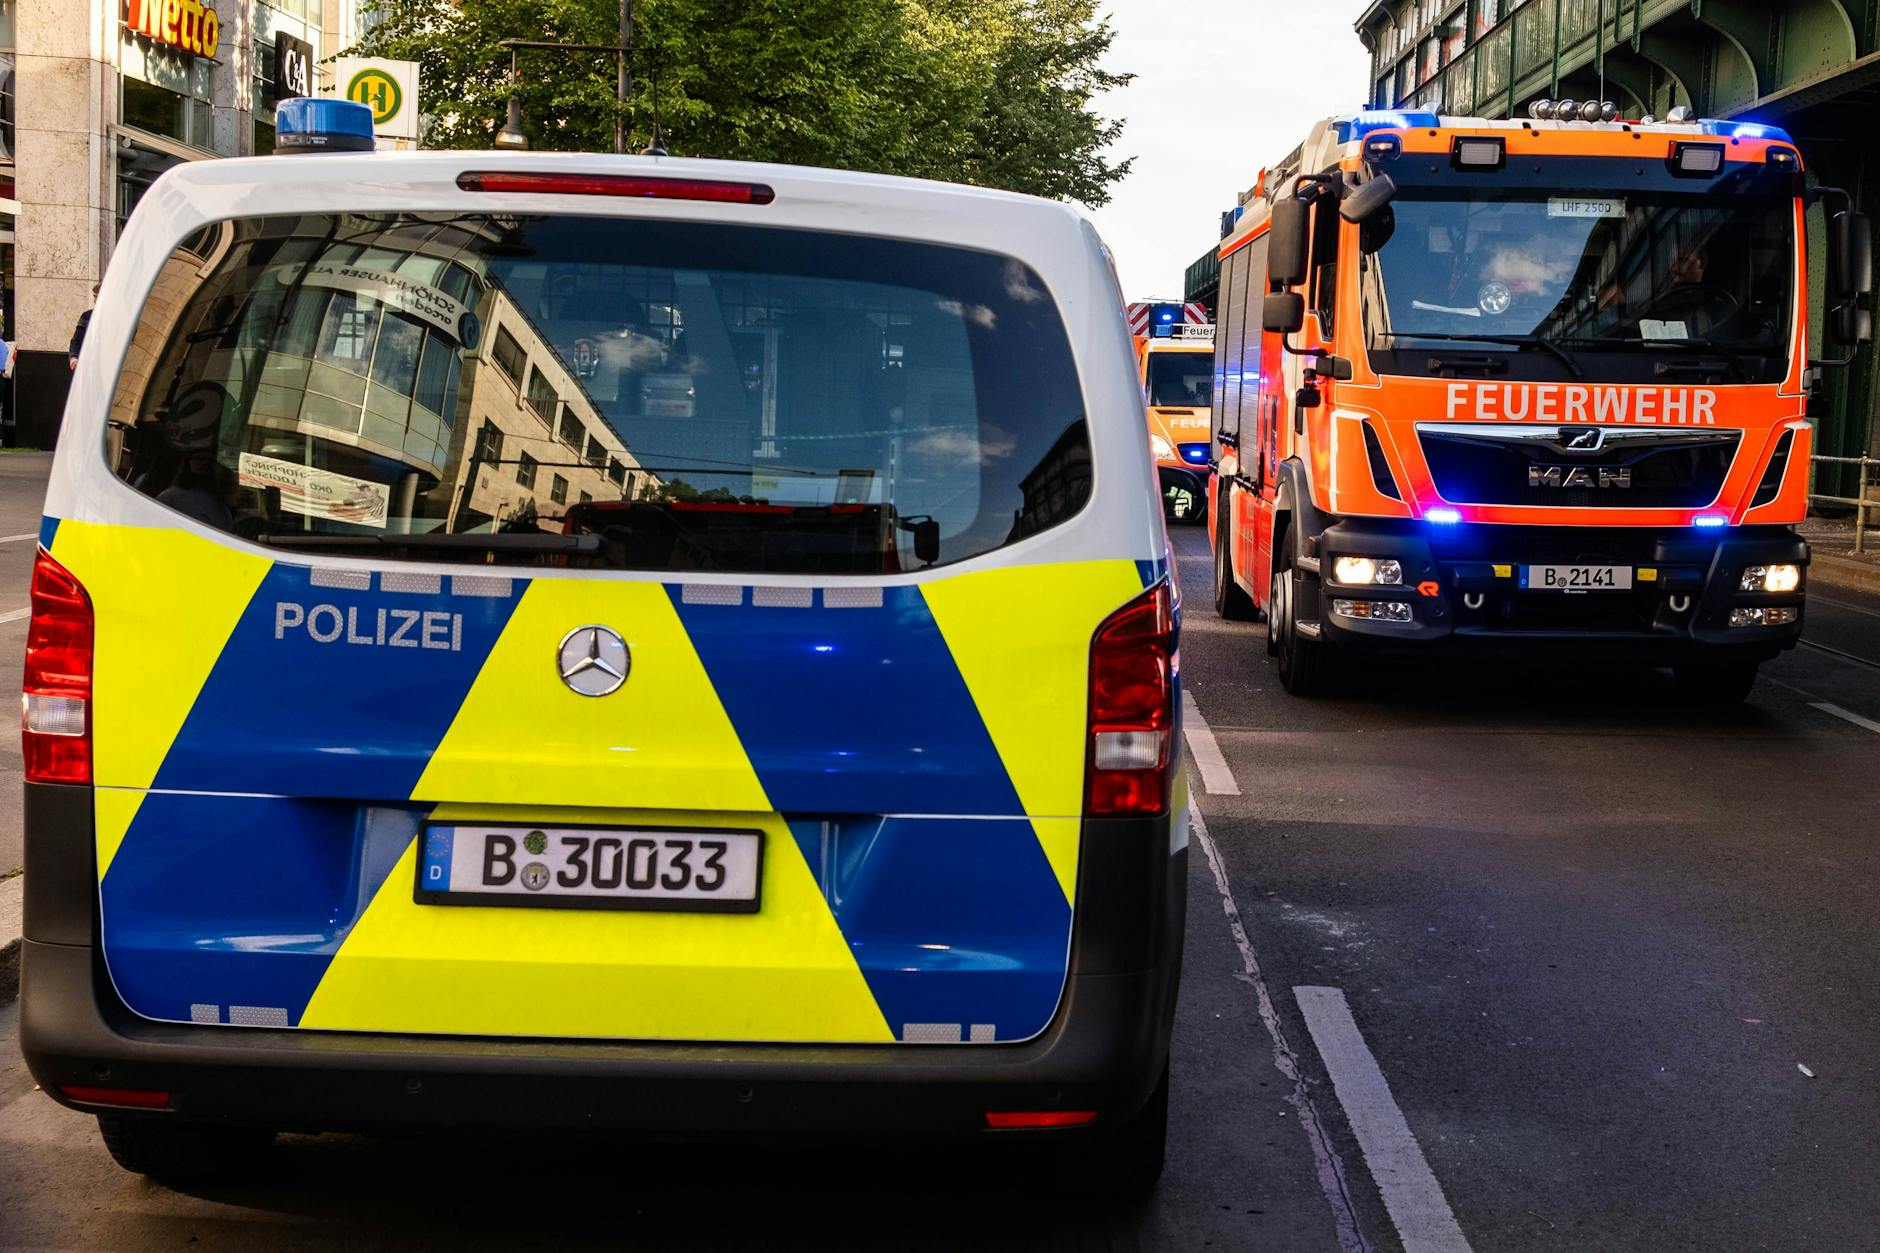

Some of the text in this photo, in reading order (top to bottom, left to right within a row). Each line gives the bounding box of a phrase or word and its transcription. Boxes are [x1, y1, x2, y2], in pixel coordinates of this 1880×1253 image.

[138, 0, 219, 58] Netto
[284, 48, 309, 97] C&A
[1562, 202, 1612, 213] LHF 2500
[1446, 383, 1717, 425] FEUERWEHR
[1528, 466, 1632, 488] MAN
[1544, 568, 1557, 586] B
[1569, 568, 1616, 587] 2141
[275, 601, 463, 652] POLIZEI
[430, 866, 442, 881] D
[482, 834, 728, 892] B 30033
